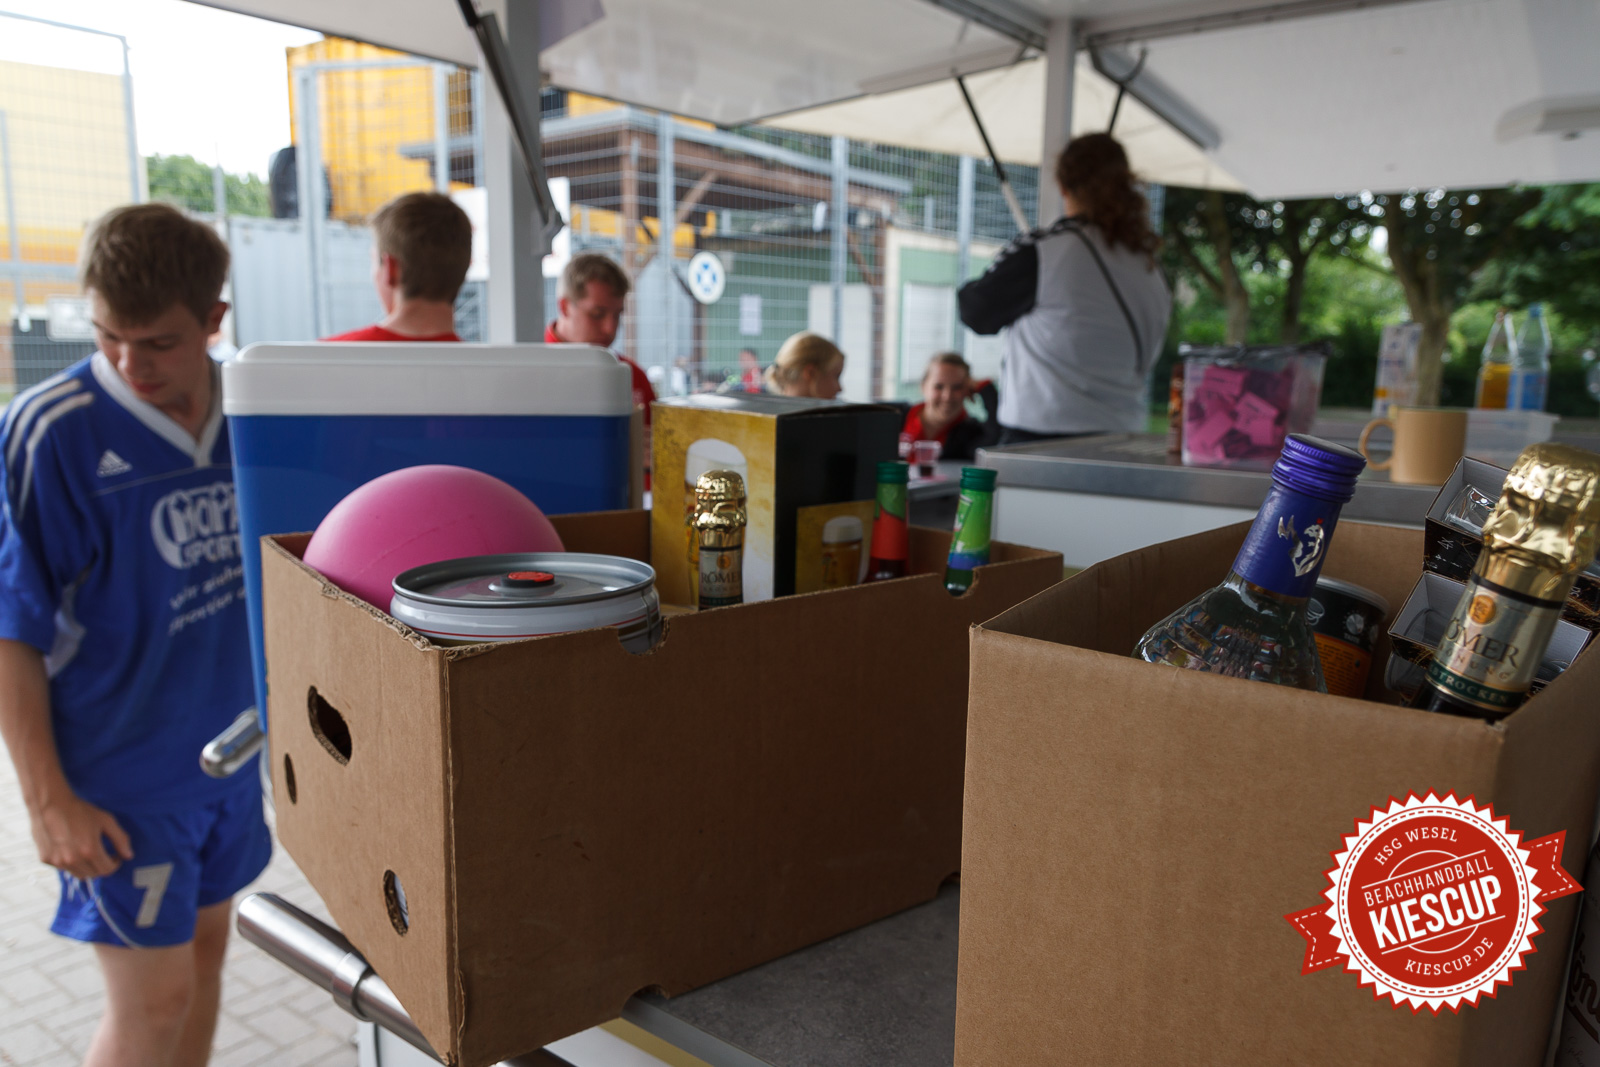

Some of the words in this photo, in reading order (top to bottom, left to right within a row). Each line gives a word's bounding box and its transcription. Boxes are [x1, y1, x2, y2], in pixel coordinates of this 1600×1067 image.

[701, 571, 740, 584] RÖME
[1444, 617, 1519, 669] ÖMER
[133, 863, 174, 927] 7
